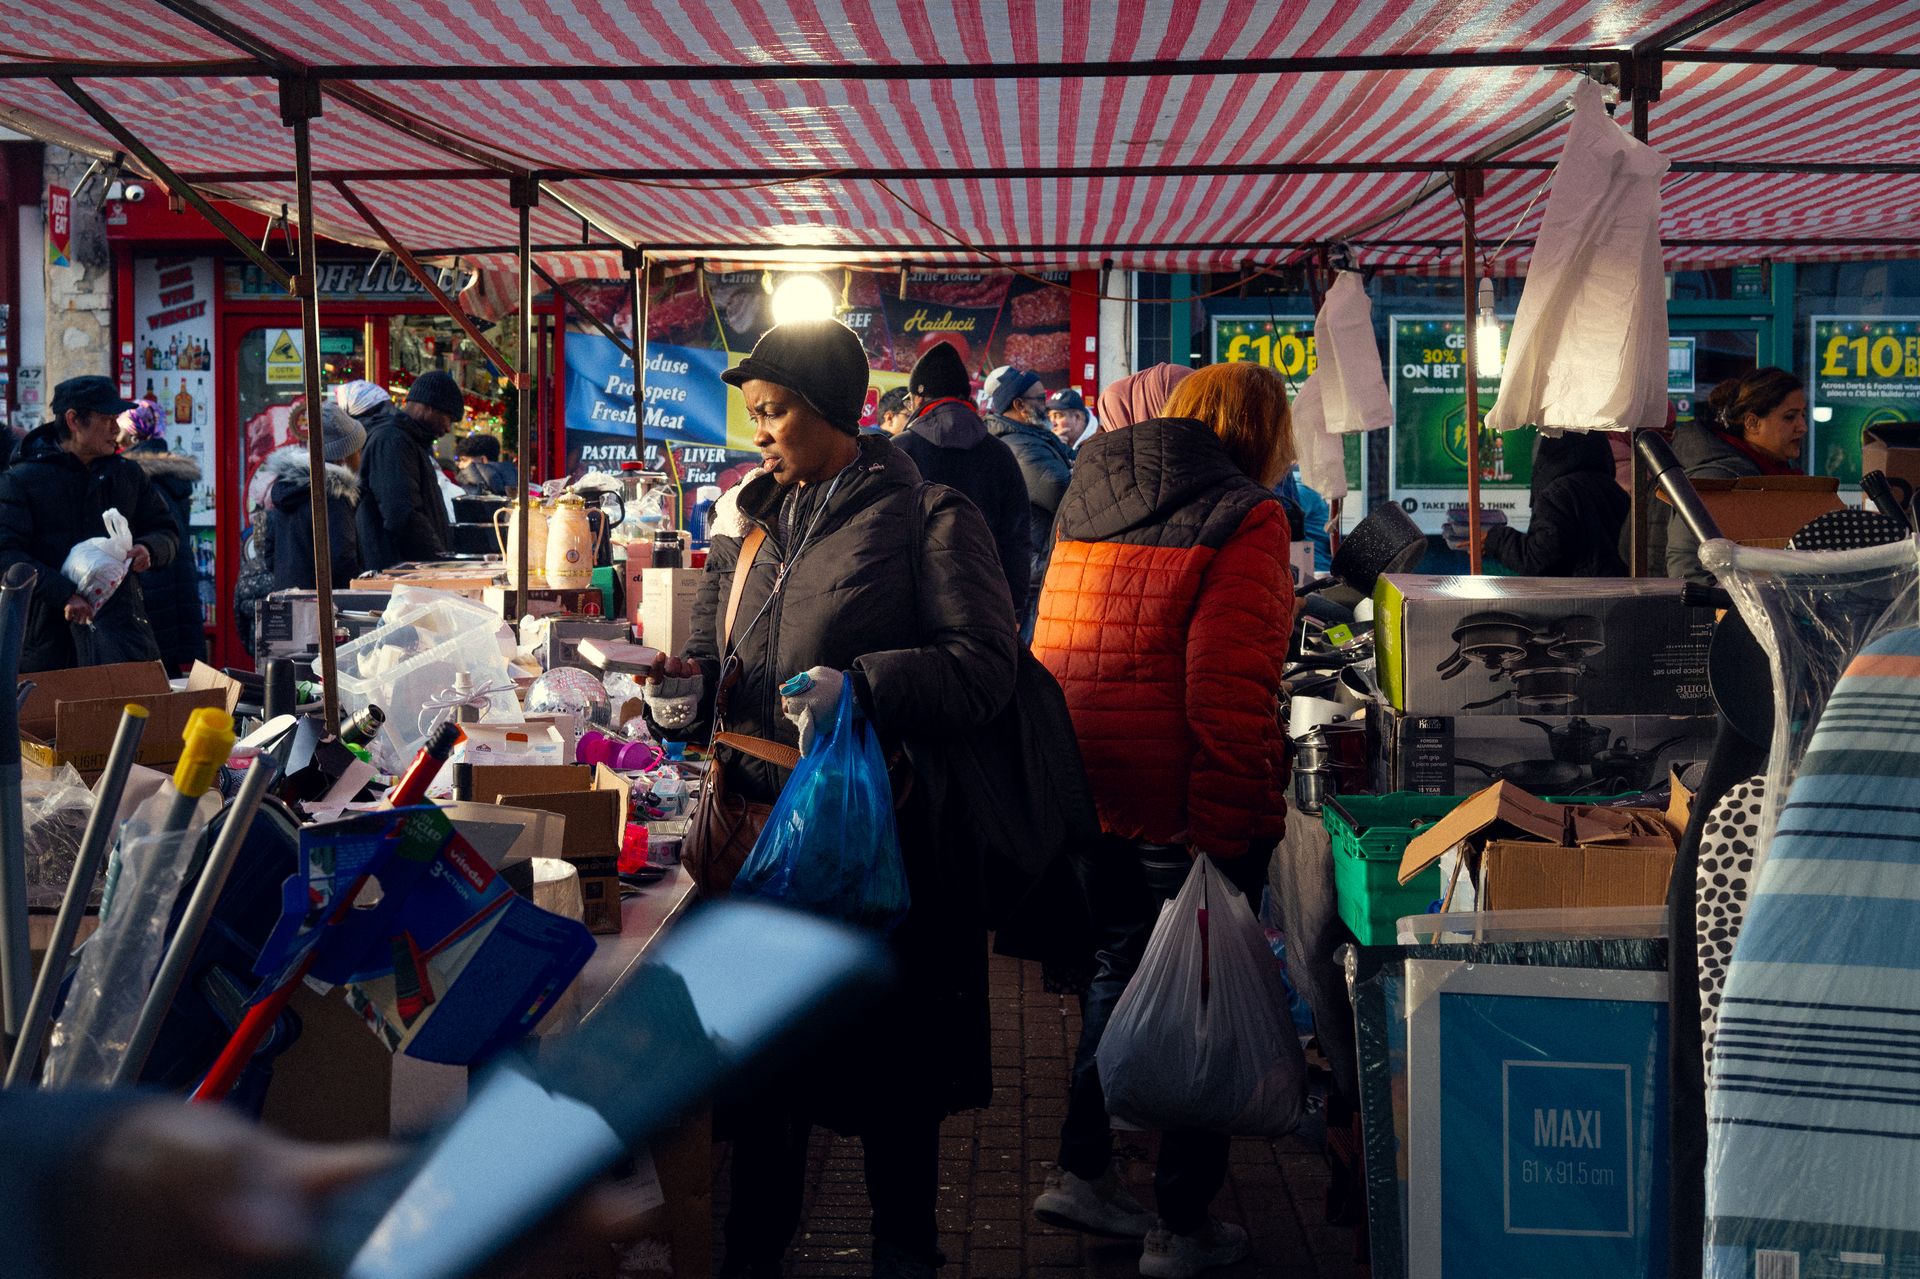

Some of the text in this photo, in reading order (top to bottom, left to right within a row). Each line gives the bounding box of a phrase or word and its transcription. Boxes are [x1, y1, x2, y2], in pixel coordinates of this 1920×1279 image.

[52, 193, 68, 215] JUST
[54, 215, 69, 235] EAT
[719, 273, 757, 285] Carne
[906, 272, 939, 282] arne
[146, 299, 207, 332] WHISKEY
[903, 308, 977, 332] Haiducii
[1445, 333, 1466, 349] GE
[619, 352, 690, 375] Poduse
[1224, 334, 1306, 376] £10
[1423, 348, 1457, 364] 30%
[1820, 335, 1904, 377] £10
[19, 369, 42, 379] 47
[1402, 364, 1429, 379] ON
[1433, 364, 1461, 379] BET
[604, 375, 688, 405] Prospete
[1874, 383, 1903, 391] Football
[590, 400, 685, 430] Fresh Meat
[683, 448, 726, 463] LIVER
[686, 468, 717, 483] Ficat
[1487, 502, 1516, 510] THINK
[1666, 667, 1682, 675] pan
[1682, 667, 1705, 676] piece
[1675, 684, 1712, 697] home
[450, 849, 484, 889] vileda
[430, 860, 470, 900] 3 ACTION
[1534, 1108, 1601, 1149] MAXI
[1522, 1159, 1615, 1186] 61 x 91.5 cm
